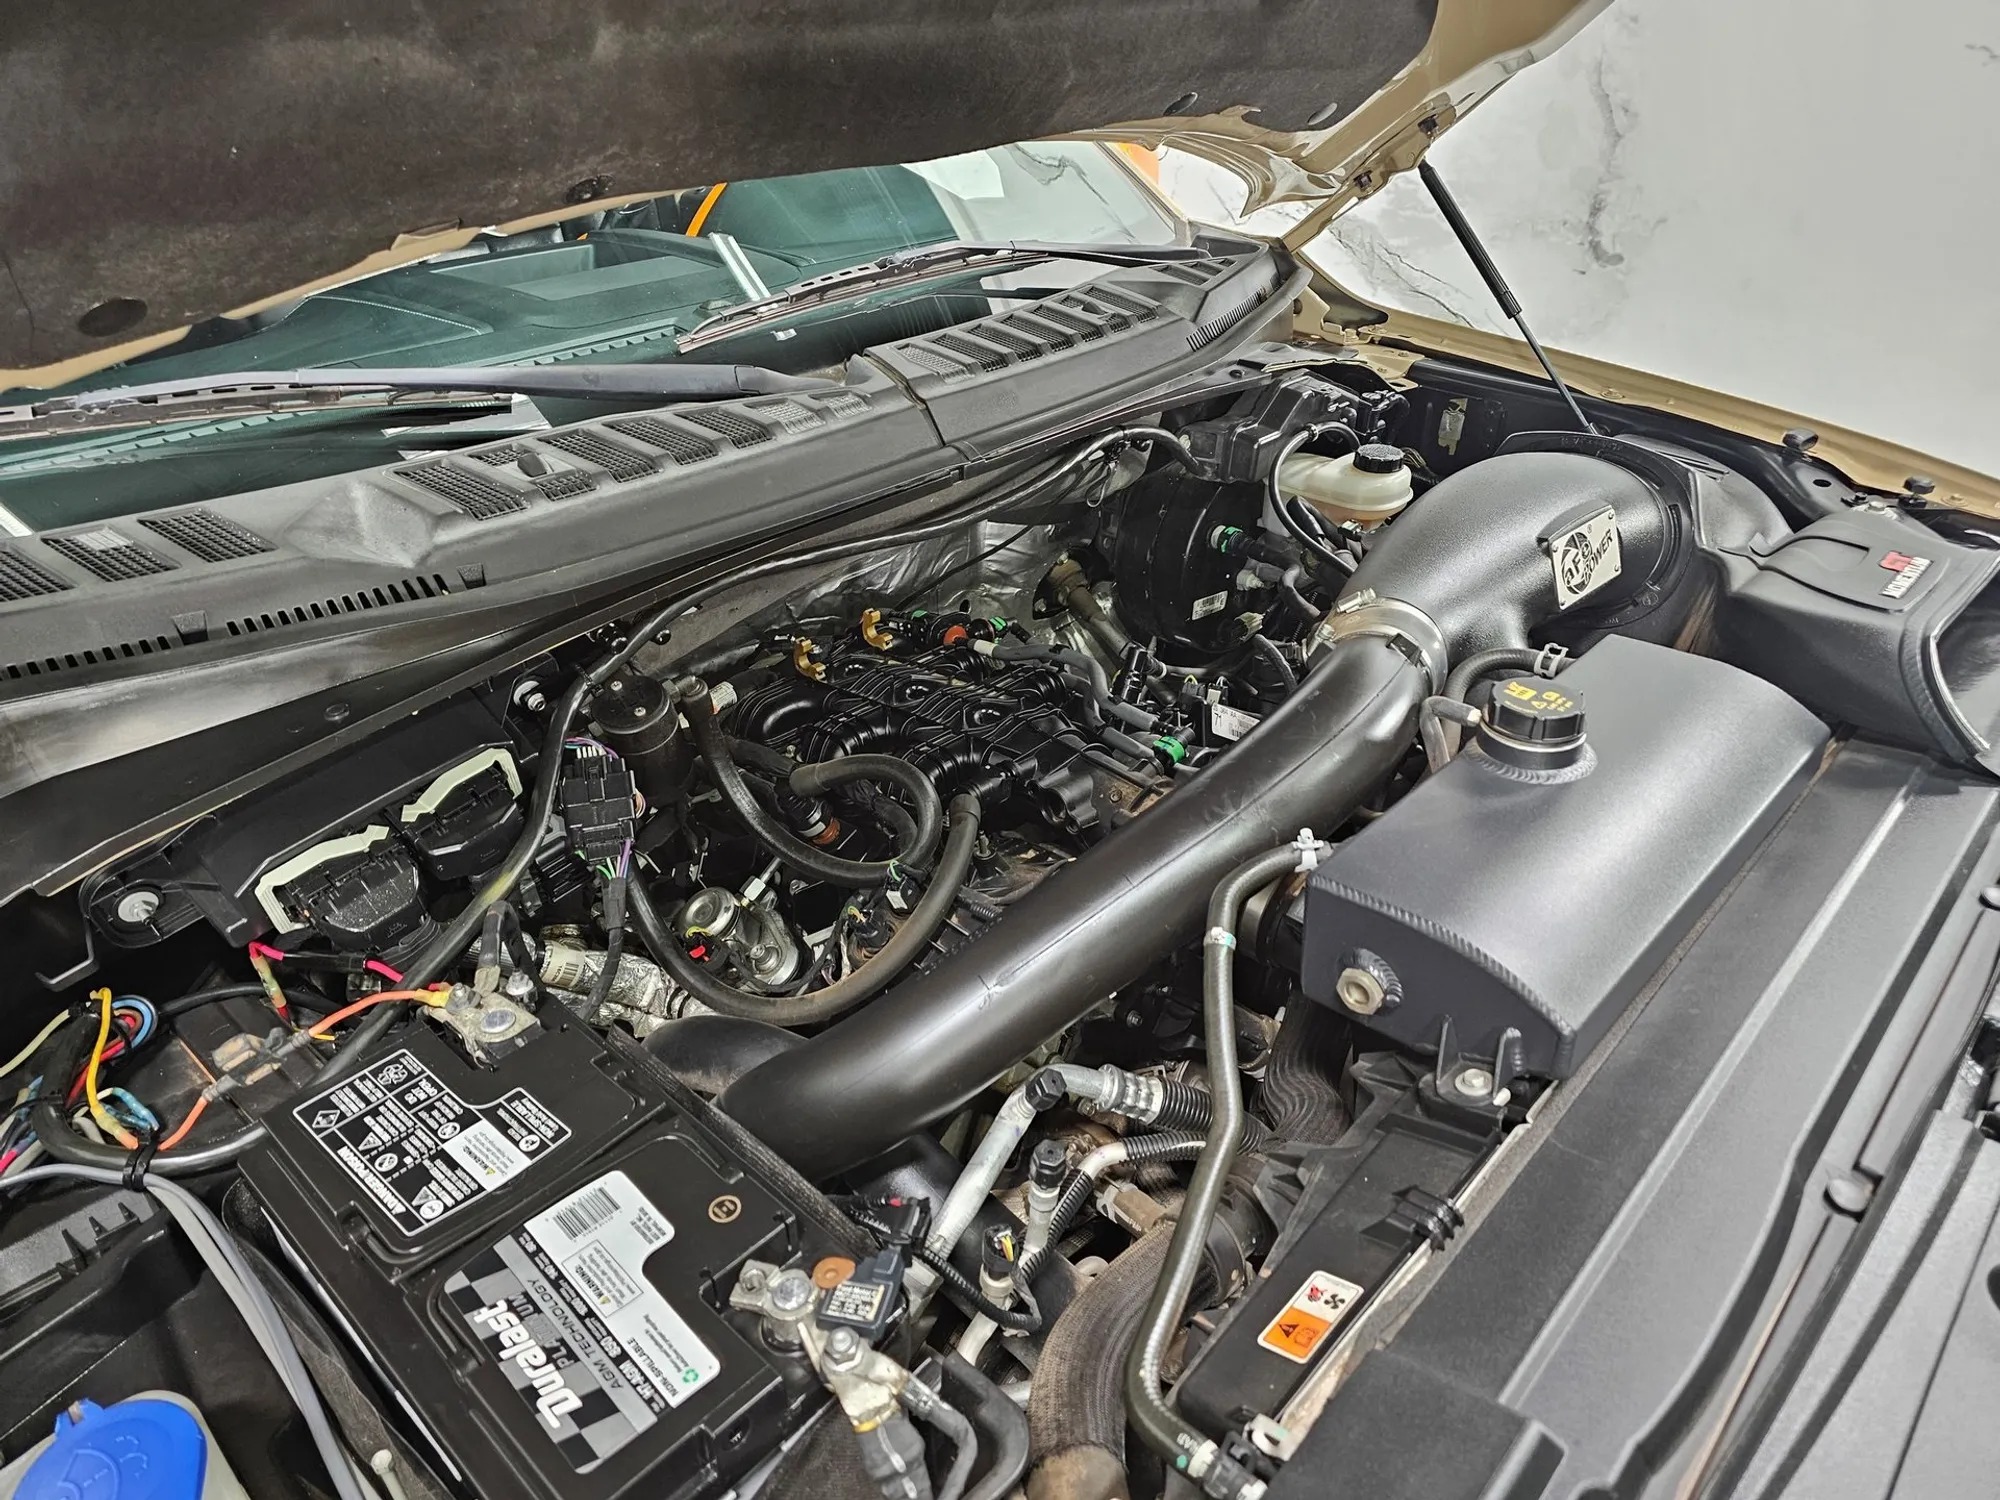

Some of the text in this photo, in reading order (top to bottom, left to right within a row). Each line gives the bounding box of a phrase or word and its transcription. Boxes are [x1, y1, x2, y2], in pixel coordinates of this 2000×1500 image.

[507, 1291, 574, 1368] PLATINUM
[527, 1279, 595, 1358] TECHNOLOGY
[470, 1297, 584, 1430] Duralast
[592, 1358, 623, 1391] AGM
